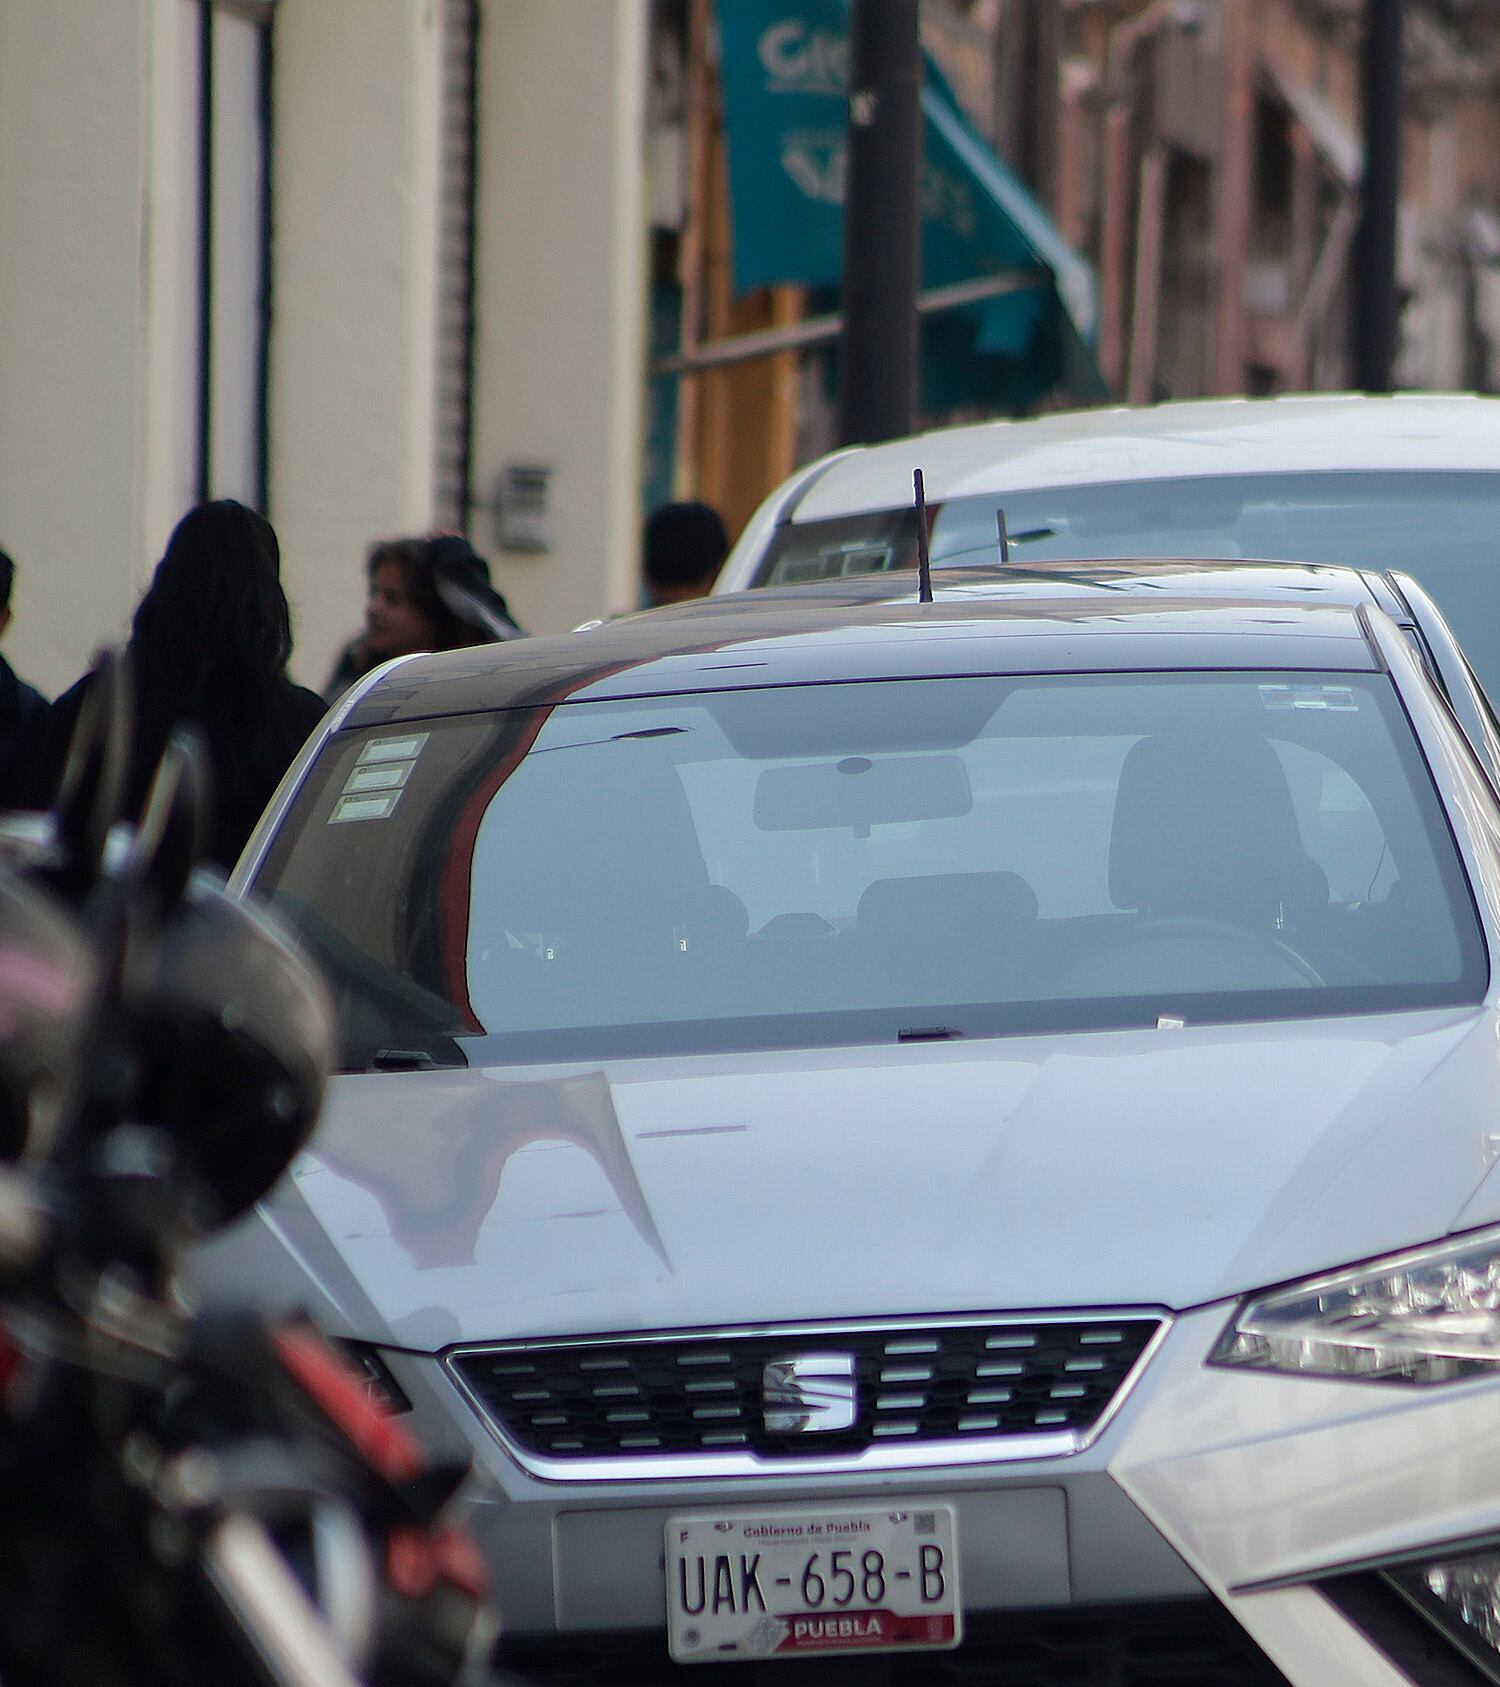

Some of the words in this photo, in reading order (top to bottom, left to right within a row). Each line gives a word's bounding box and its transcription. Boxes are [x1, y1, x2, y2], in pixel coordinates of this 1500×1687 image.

[743, 1523, 802, 1538] Gobierno
[806, 1525, 822, 1536] de
[826, 1521, 870, 1533] Puebla
[679, 1544, 945, 1616] UAK-658-B
[794, 1616, 882, 1638] PUEBLA
